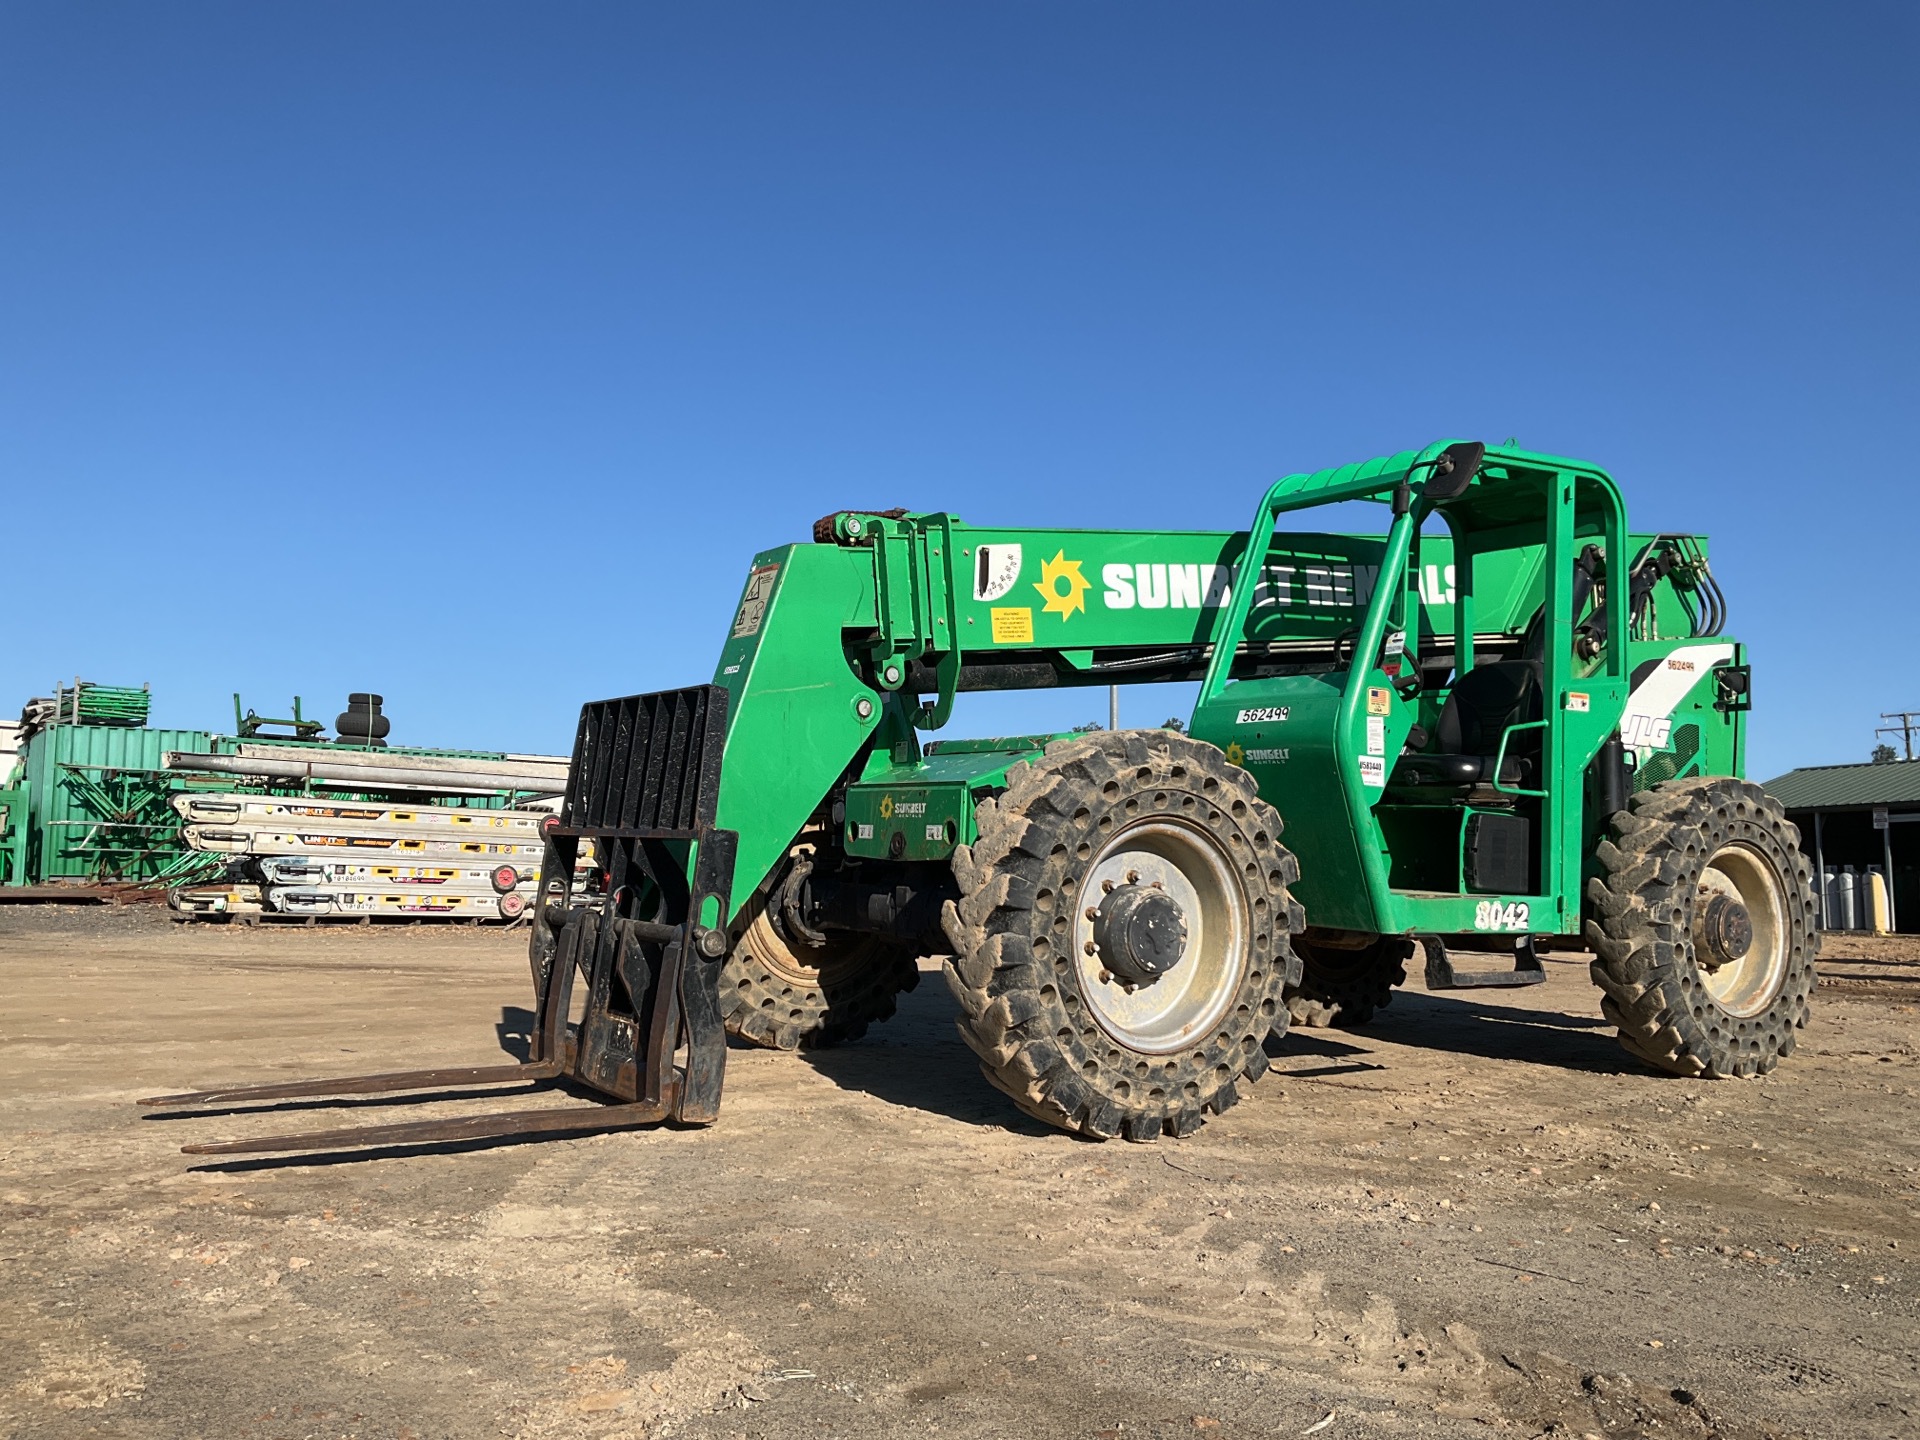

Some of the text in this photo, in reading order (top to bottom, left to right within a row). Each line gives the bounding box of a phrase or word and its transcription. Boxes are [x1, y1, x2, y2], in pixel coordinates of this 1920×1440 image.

[1101, 563, 1295, 609] SUNBLT
[1667, 659, 1695, 672] 562499
[1242, 706, 1290, 722] 562499
[1620, 714, 1673, 749] JLG
[1245, 748, 1290, 761] SUNBELT
[894, 802, 927, 814] SUNBELT
[1474, 901, 1530, 931] 8042
